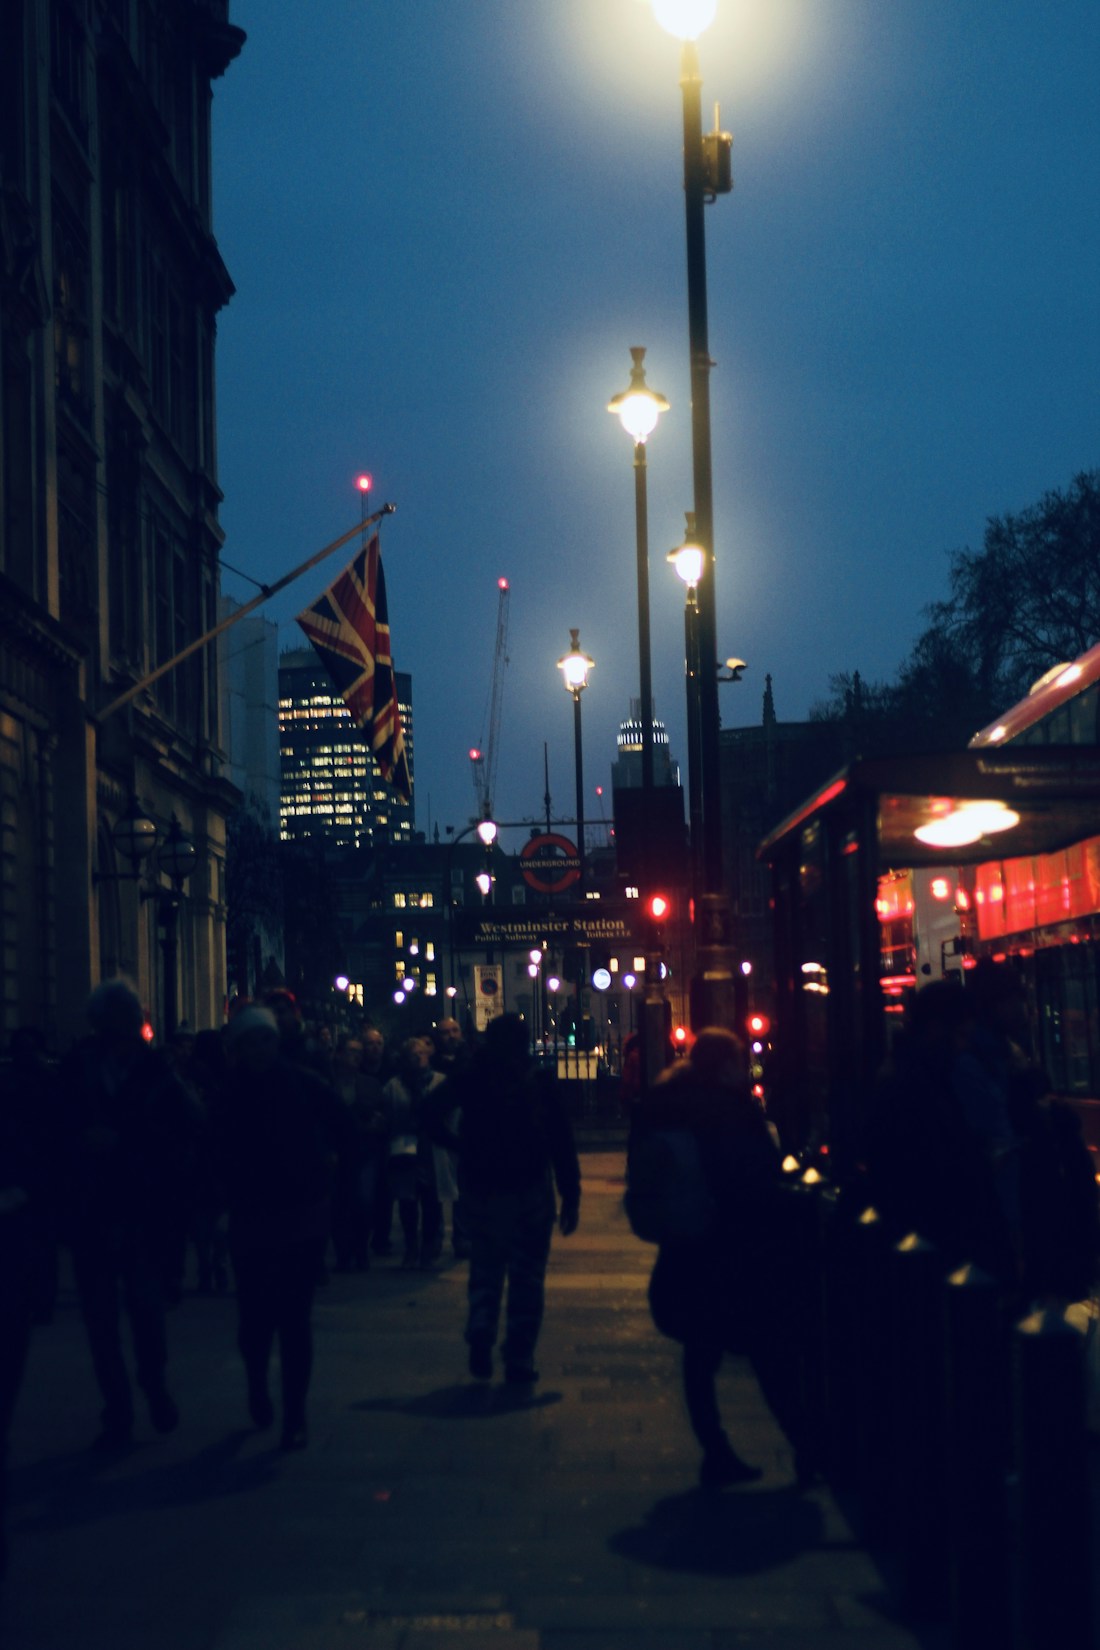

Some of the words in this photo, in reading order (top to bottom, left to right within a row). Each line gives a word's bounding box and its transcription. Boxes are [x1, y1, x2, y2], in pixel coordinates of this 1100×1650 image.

[519, 859, 581, 868] UNDERGROUND
[480, 921, 569, 933] Westminster
[573, 918, 625, 931] Station
[474, 934, 502, 942] Public
[505, 933, 538, 942] Subway
[586, 930, 614, 939] Toilets
